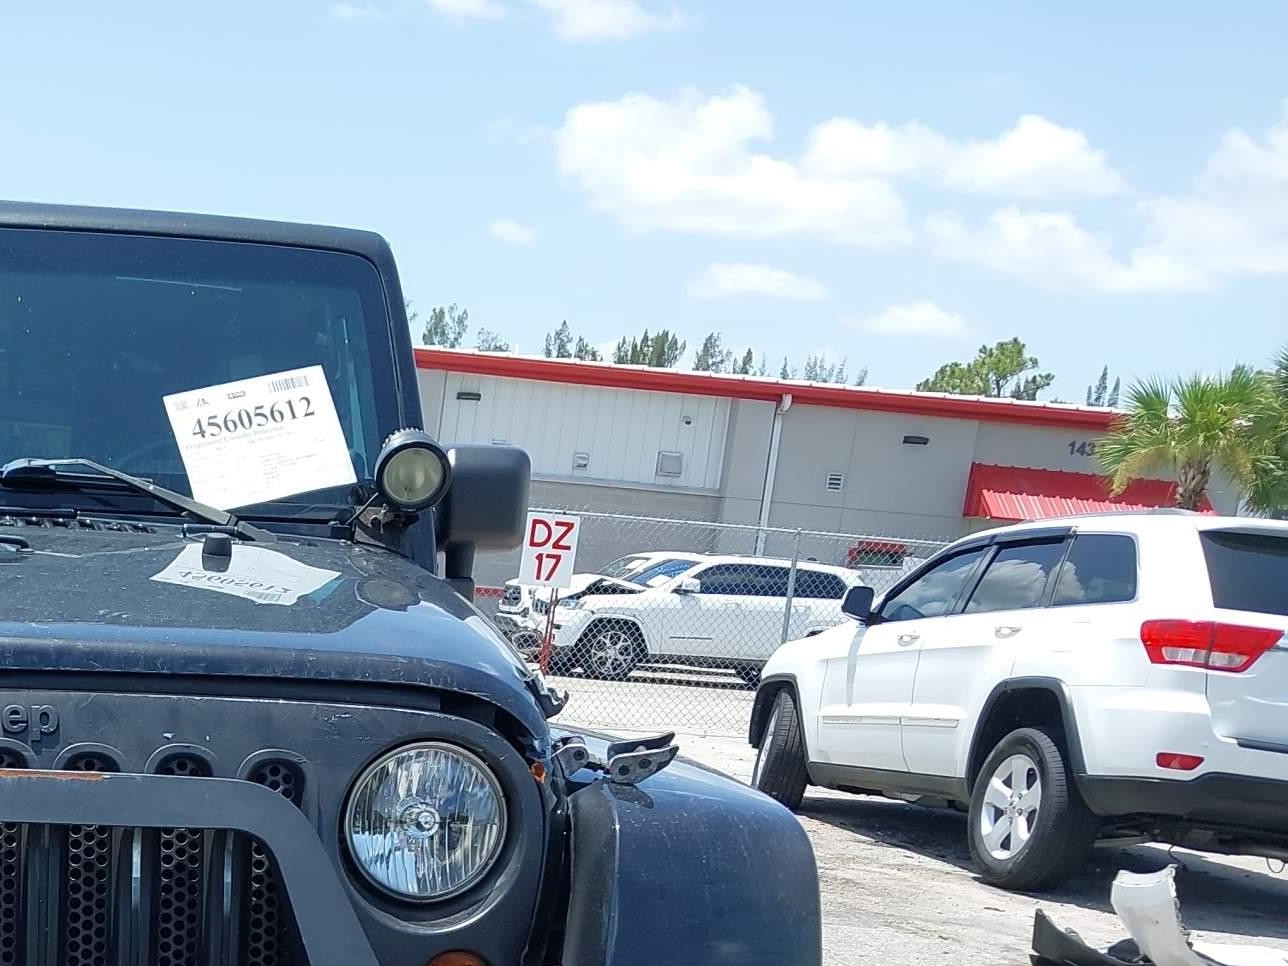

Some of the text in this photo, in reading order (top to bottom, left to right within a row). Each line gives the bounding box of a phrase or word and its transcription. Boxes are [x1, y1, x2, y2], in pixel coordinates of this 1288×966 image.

[192, 396, 315, 439] 45605612
[529, 518, 574, 550] DZ
[535, 553, 562, 581] 17
